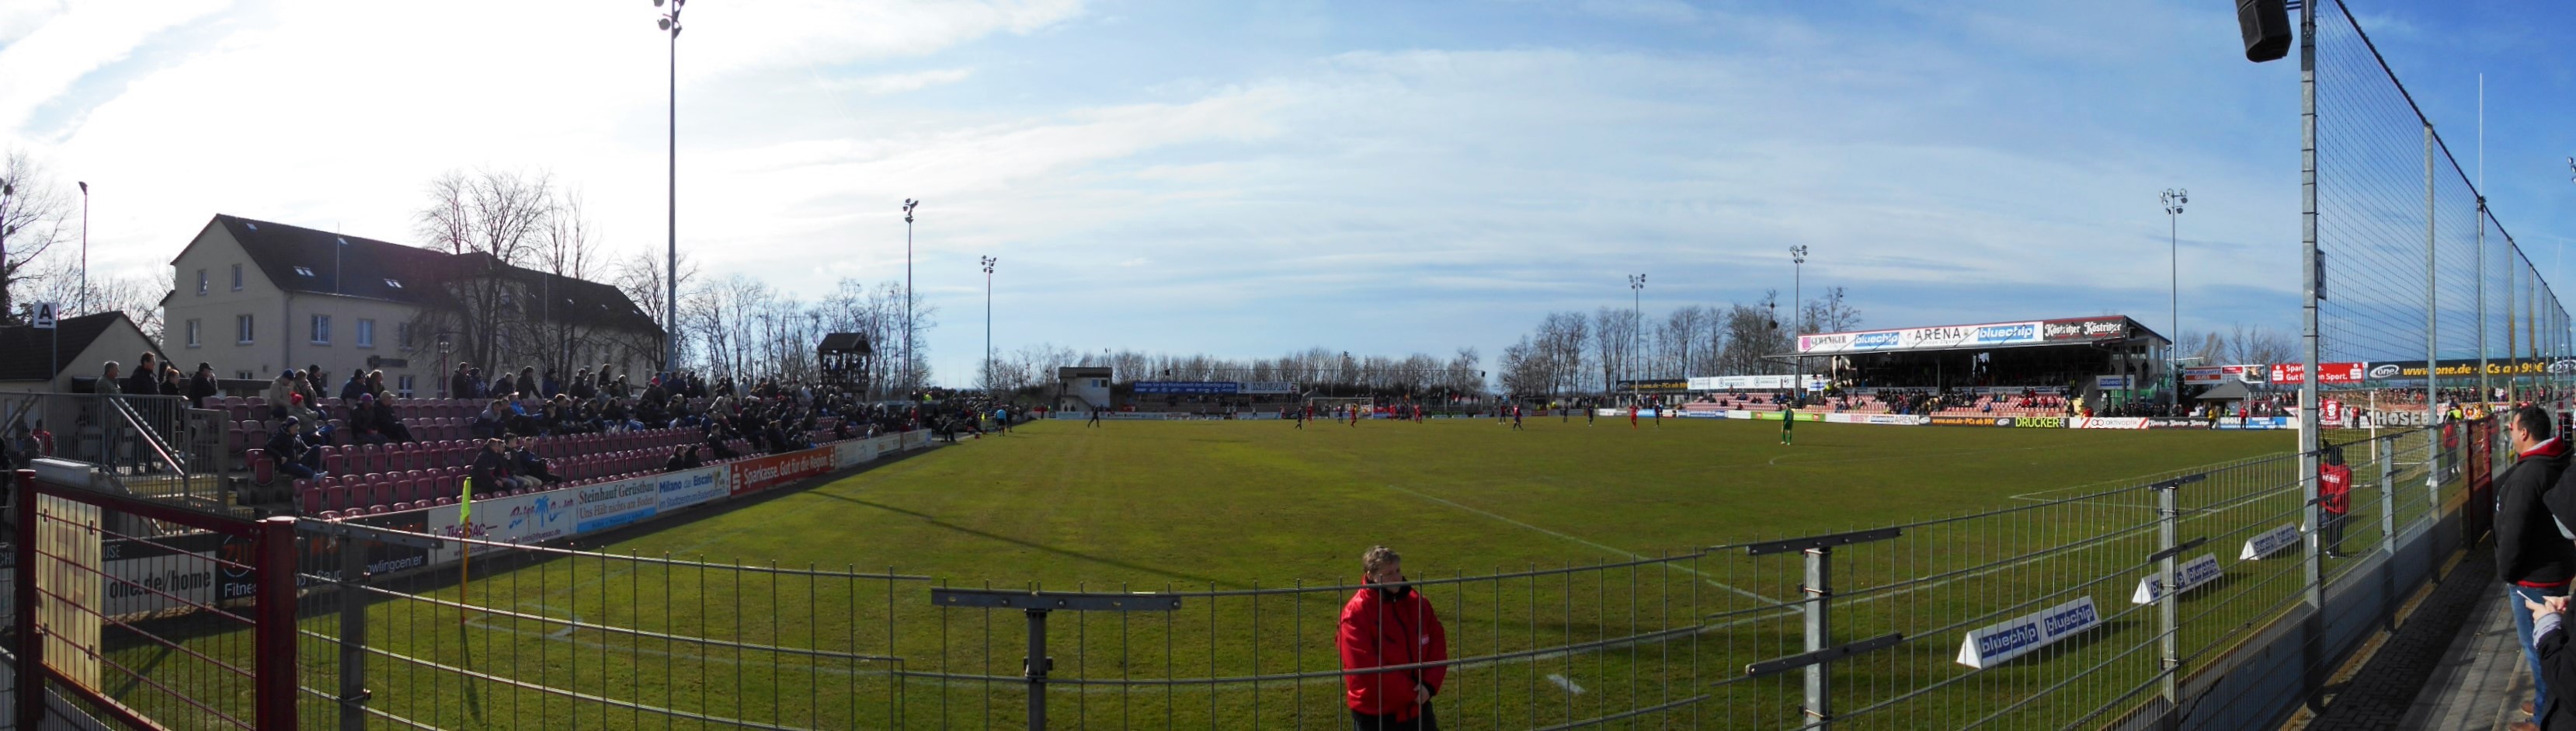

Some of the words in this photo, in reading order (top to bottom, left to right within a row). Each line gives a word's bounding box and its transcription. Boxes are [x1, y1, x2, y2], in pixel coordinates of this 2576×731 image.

[39, 305, 52, 319] A
[1855, 333, 1898, 346] bluechip
[1915, 327, 1962, 341] ARENA
[1980, 326, 2033, 339] bluechip
[1894, 416, 1919, 424] ARENA
[2015, 417, 2060, 428] DRUCKER
[744, 466, 779, 486] Sparkasse.
[780, 461, 791, 477] Gut
[791, 459, 800, 473] für
[809, 454, 828, 472] Region.
[579, 484, 618, 504] Steinhauf
[618, 481, 655, 497] Gerüstbau
[659, 480, 683, 494] Milano
[579, 507, 593, 519] Uns
[109, 569, 211, 600] one.de/home
[1982, 627, 2037, 653] bluechip
[2046, 607, 2093, 632] bluechip
